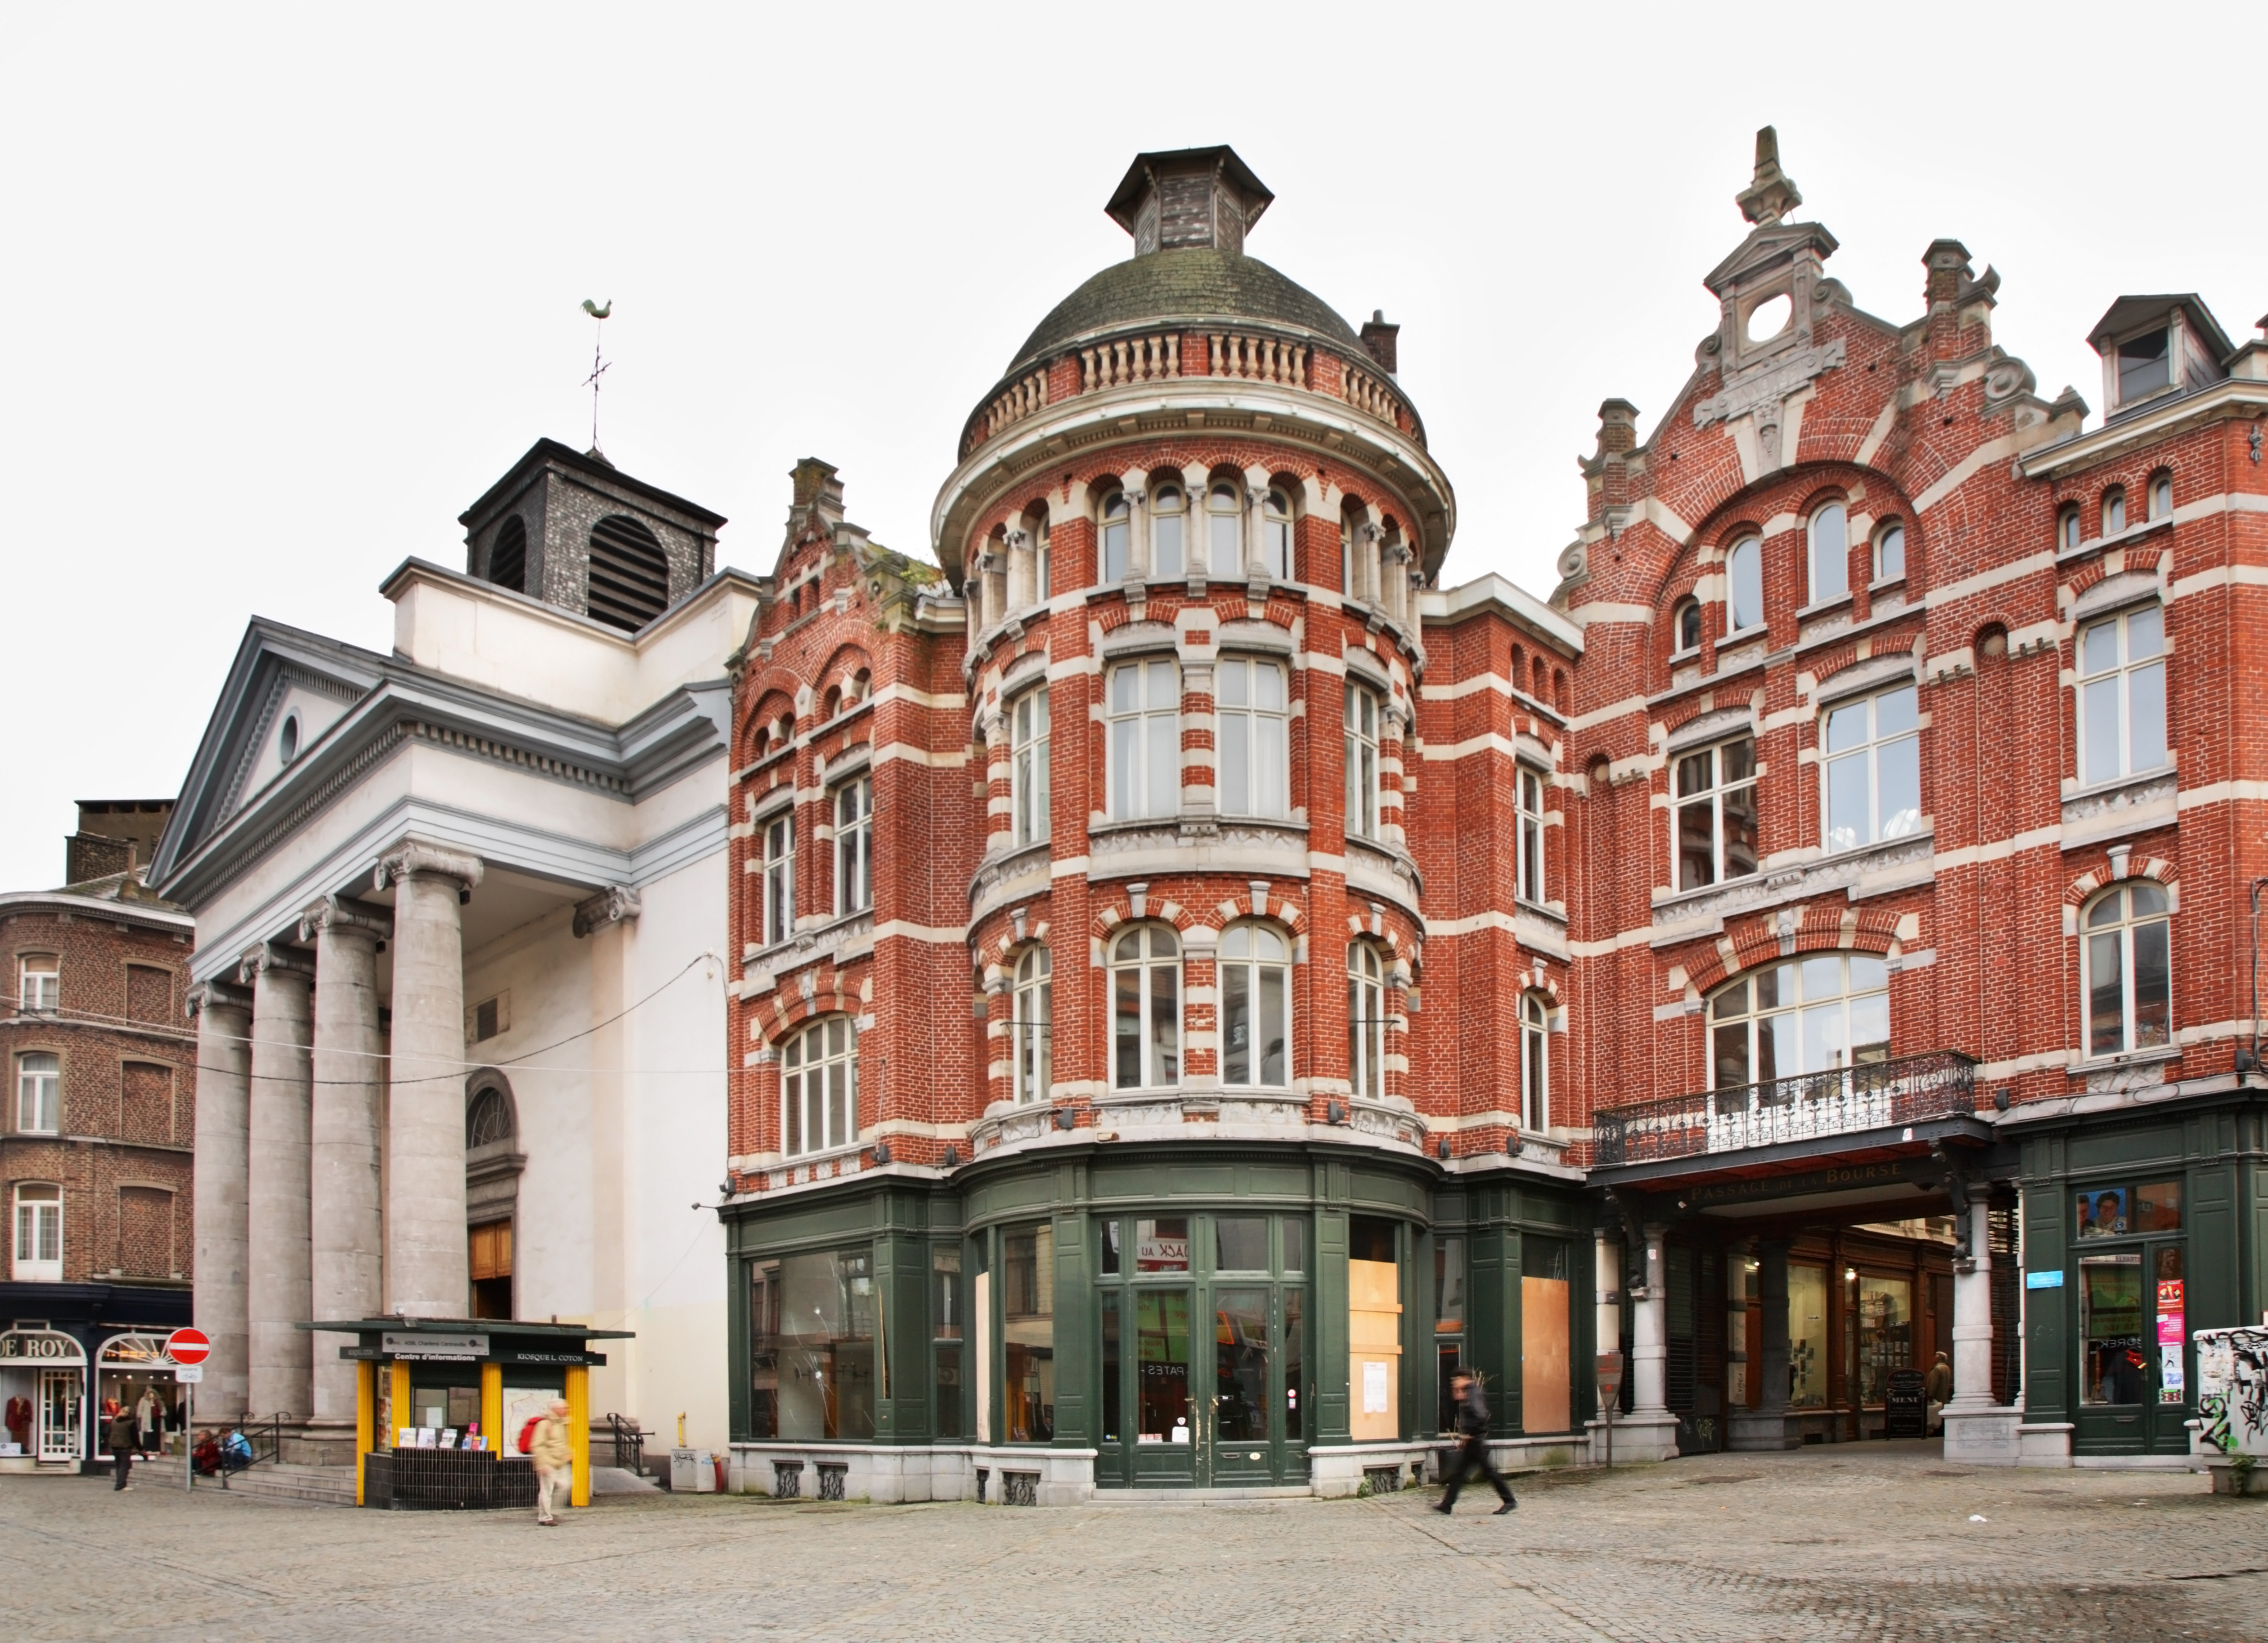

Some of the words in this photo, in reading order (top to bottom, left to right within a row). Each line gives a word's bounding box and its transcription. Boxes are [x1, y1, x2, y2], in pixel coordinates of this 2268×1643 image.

[1692, 1181, 1769, 1200] PASSAGE
[1779, 1180, 1794, 1189] DE
[1802, 1177, 1817, 1187] LA
[1827, 1163, 1902, 1184] BOURSE
[26, 1339, 70, 1357] ROY
[422, 1353, 476, 1361] d'informations
[517, 1353, 550, 1361] KIOSQUE
